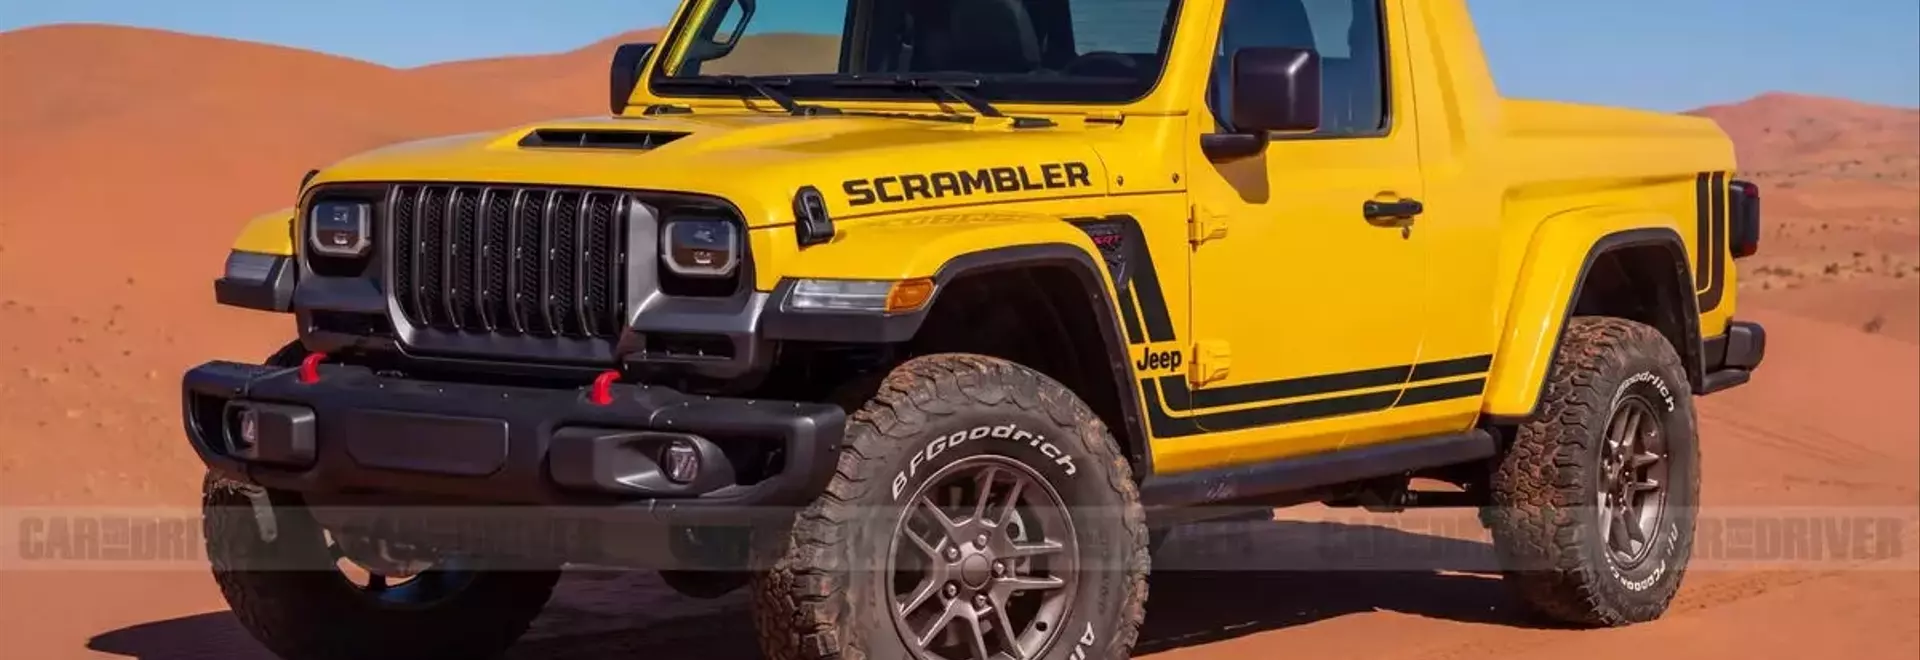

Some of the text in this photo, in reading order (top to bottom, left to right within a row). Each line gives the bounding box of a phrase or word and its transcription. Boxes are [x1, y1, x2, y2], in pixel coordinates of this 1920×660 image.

[842, 161, 1092, 206] SCRAMBLER
[1136, 347, 1182, 372] Jeep
[891, 423, 1077, 501] BFGoodrich
